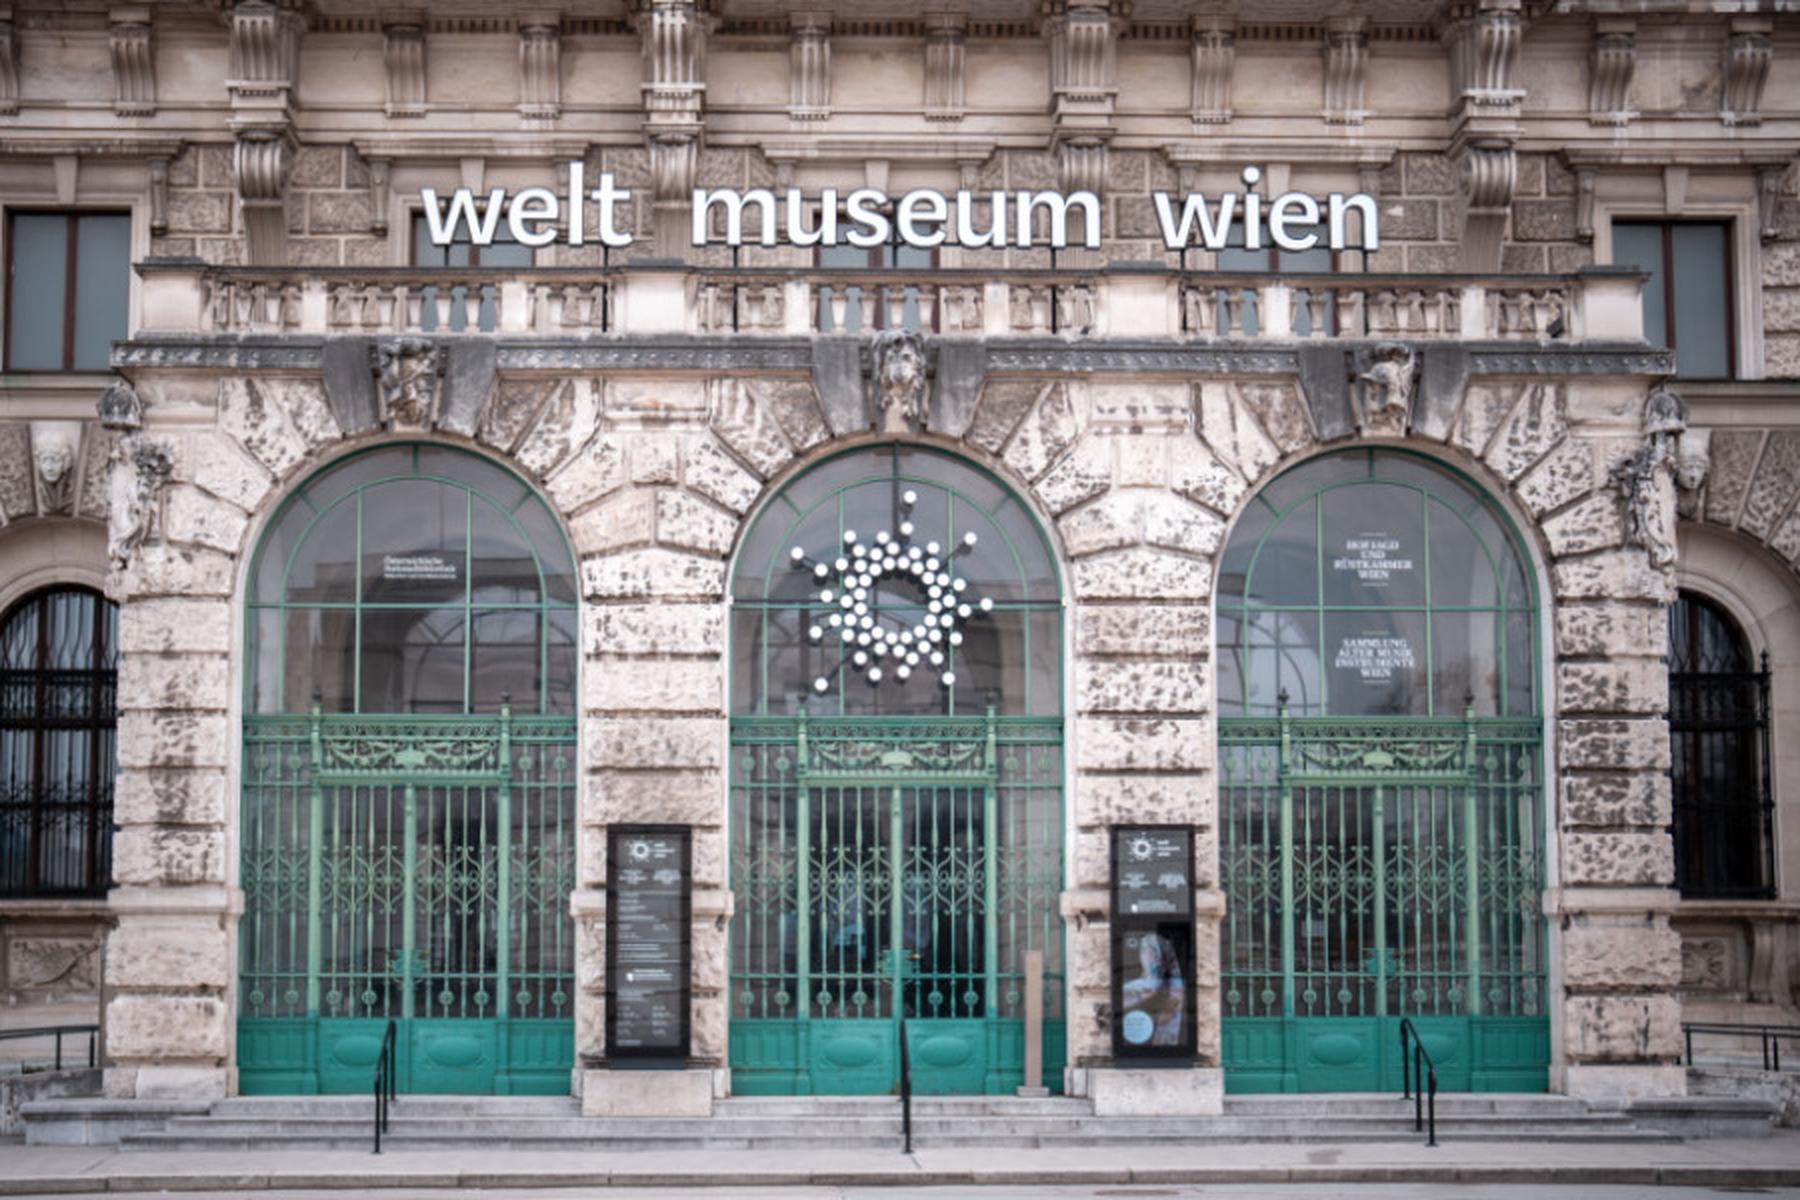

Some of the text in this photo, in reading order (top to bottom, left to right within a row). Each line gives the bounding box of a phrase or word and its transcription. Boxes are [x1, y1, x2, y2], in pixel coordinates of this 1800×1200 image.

[421, 161, 1379, 250] welt museum wien
[1357, 569, 1390, 579] WIEN
[1360, 668, 1392, 678] WIEN
